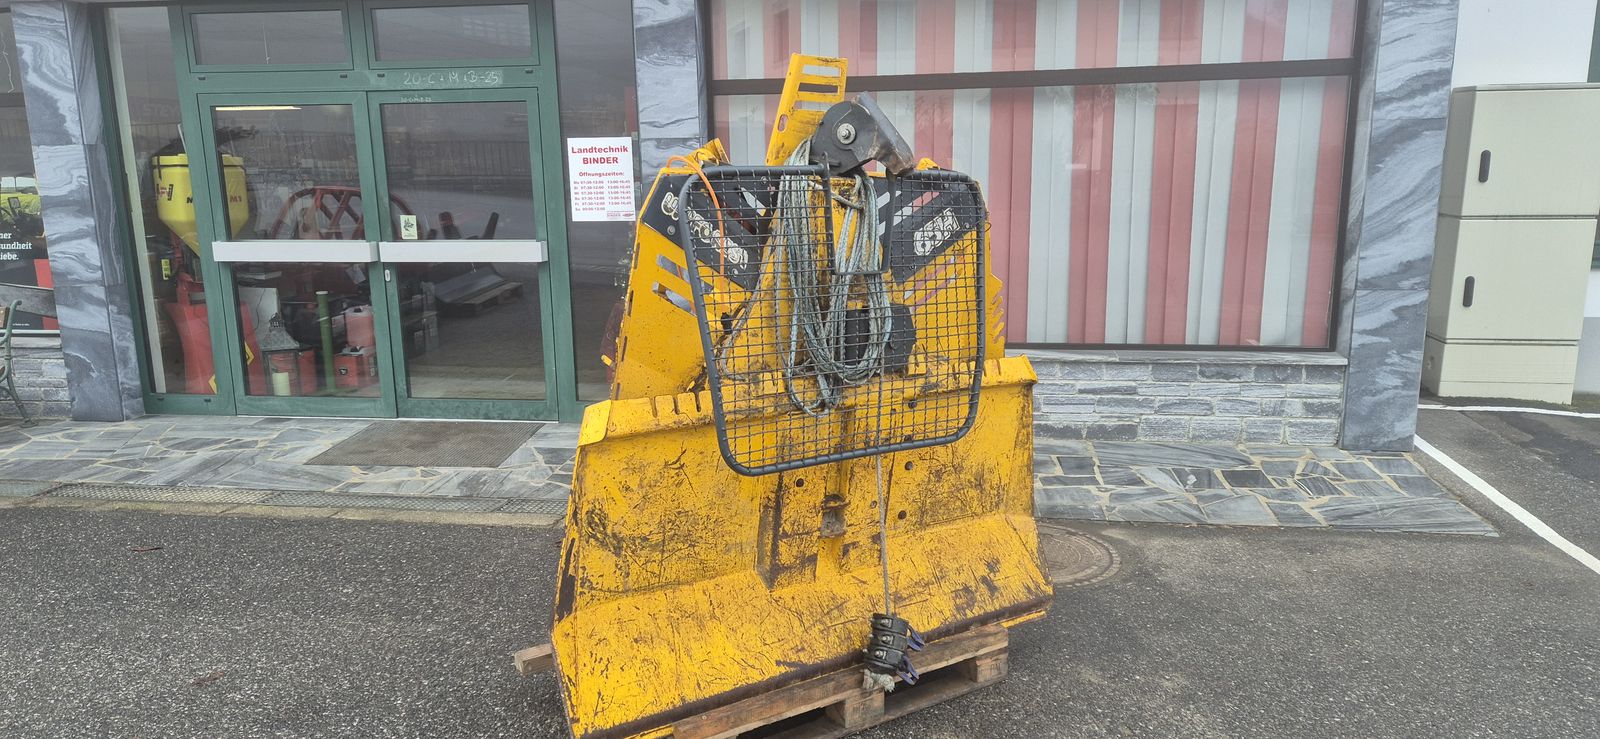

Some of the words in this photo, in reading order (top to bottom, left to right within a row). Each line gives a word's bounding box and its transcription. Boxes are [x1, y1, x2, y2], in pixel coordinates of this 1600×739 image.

[571, 145, 629, 154] Landtechnik
[582, 156, 619, 164] BINDER
[0, 241, 33, 250] undheit
